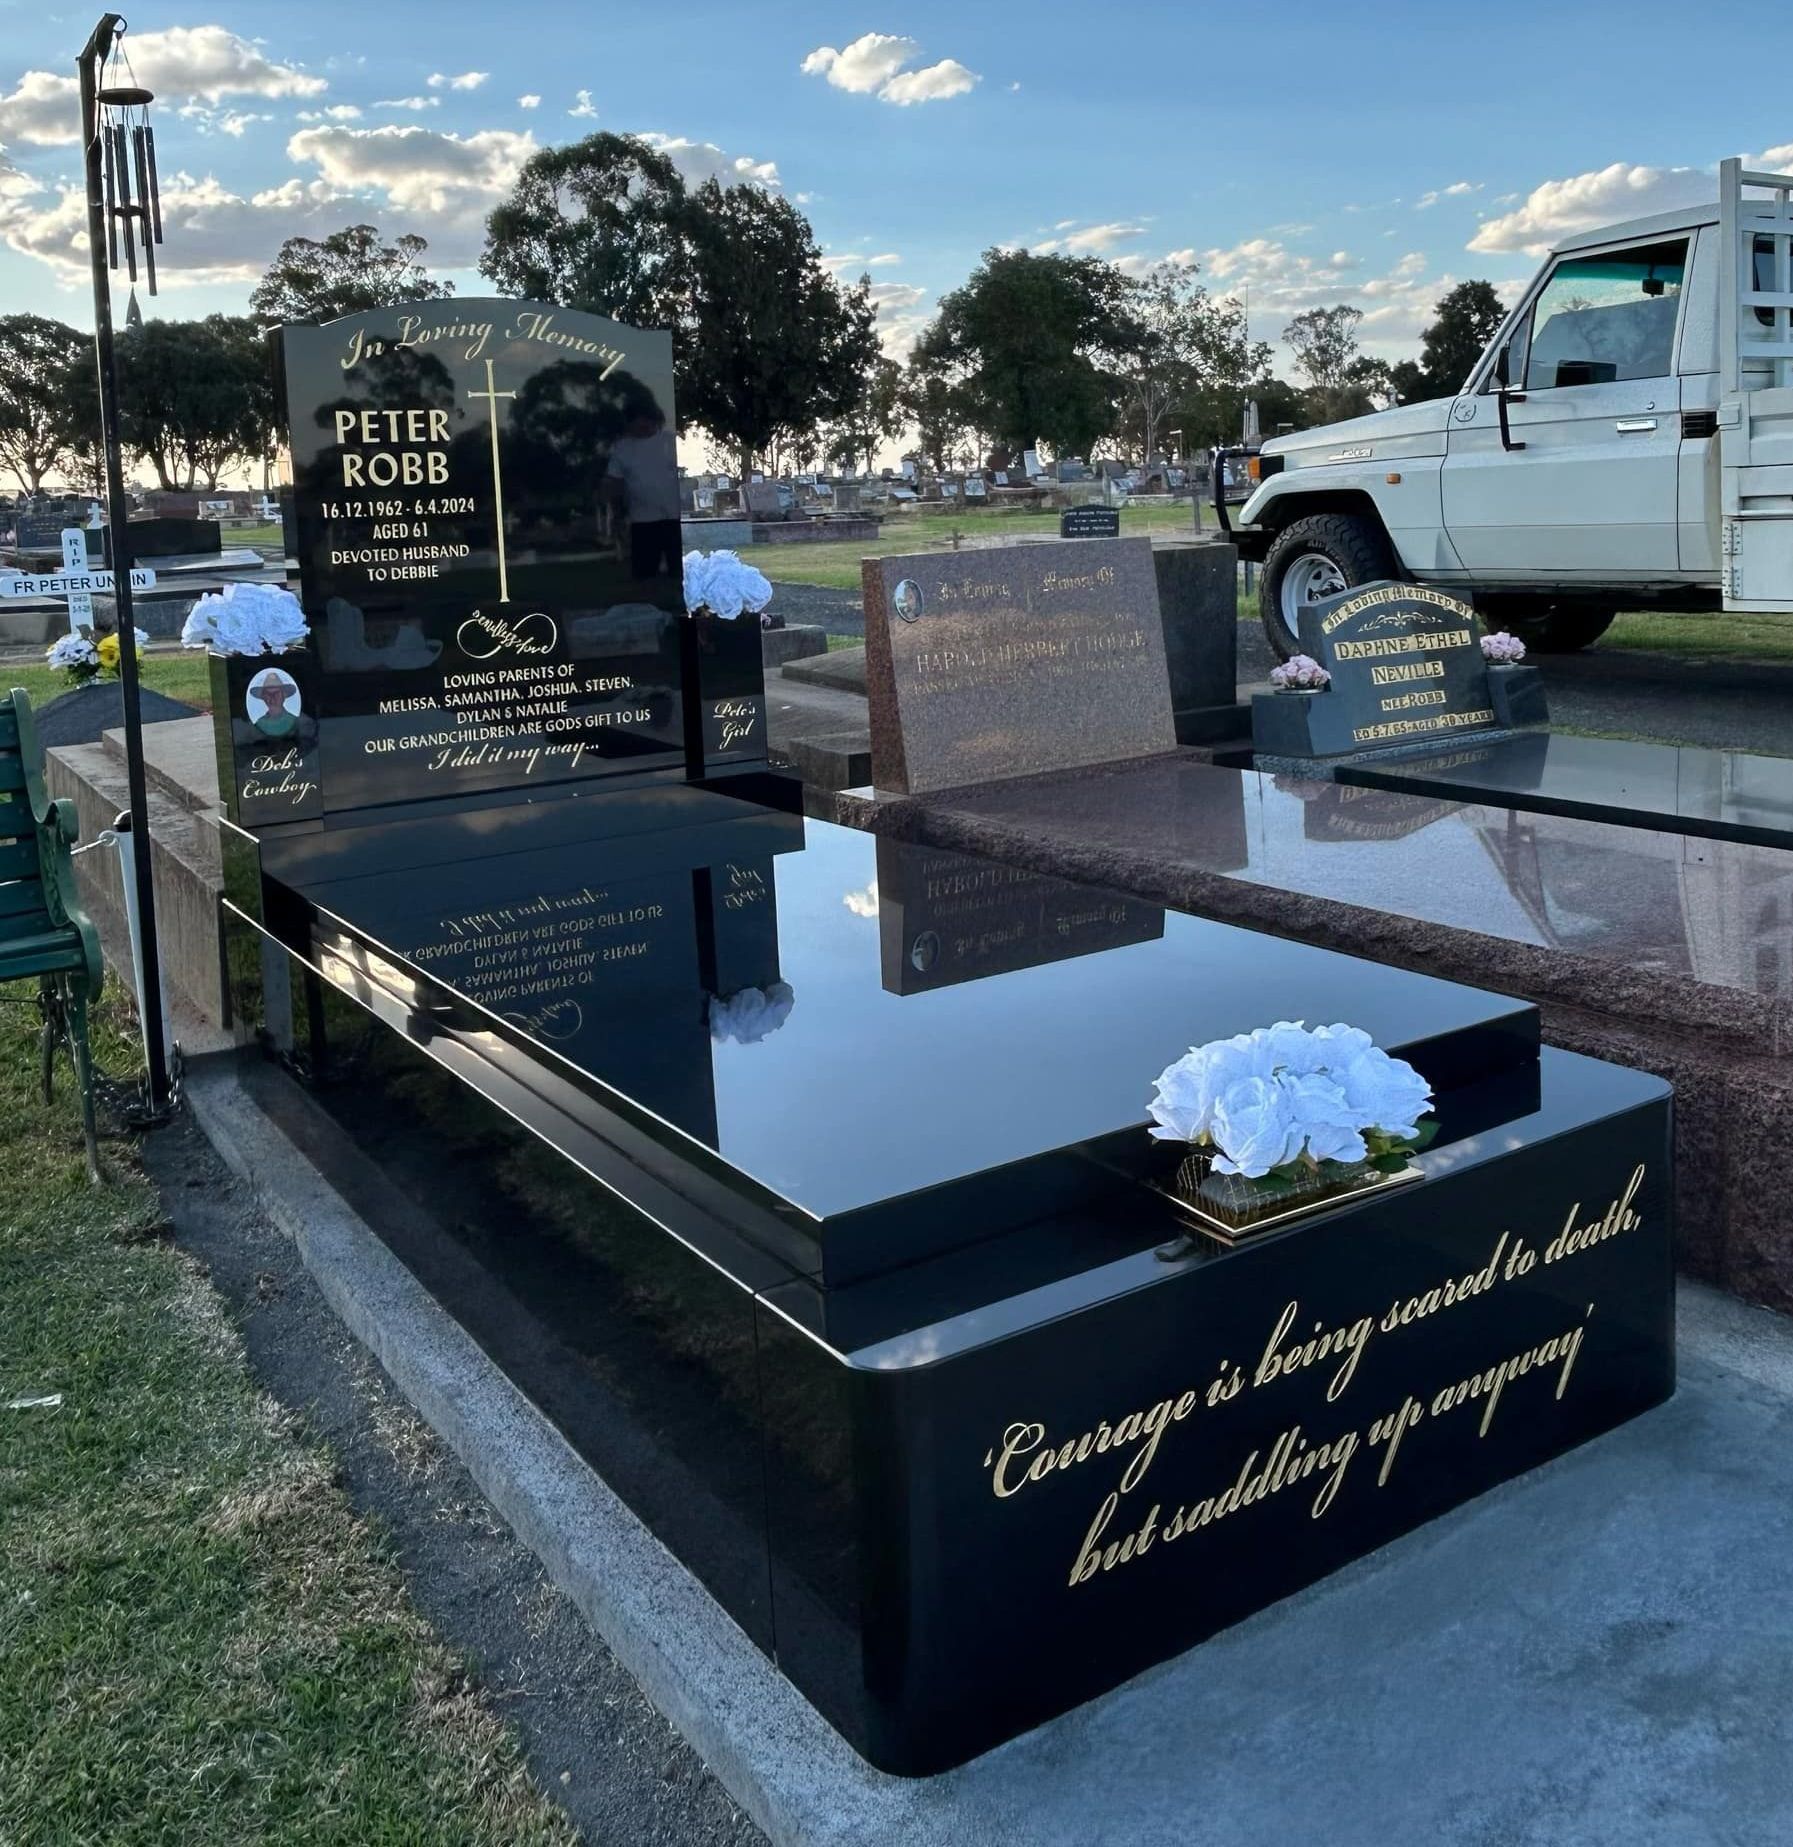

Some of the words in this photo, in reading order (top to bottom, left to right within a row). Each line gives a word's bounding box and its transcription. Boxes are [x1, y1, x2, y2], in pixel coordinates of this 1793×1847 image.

[341, 328, 385, 370] In
[394, 315, 495, 360] Loving
[505, 312, 626, 381] Memory
[335, 409, 451, 444] PETER
[343, 452, 450, 487] ROBB
[322, 502, 403, 519] 16.12.1962
[415, 498, 475, 515] 6.4.2024
[373, 523, 409, 540] AGED
[413, 521, 428, 538] 61
[331, 547, 399, 565] DEVOTED
[402, 544, 470, 562] HUSBAND
[14, 581, 35, 593] FR
[40, 578, 91, 592] PETER
[96, 574, 146, 588] UNIN
[367, 567, 387, 582] TO
[391, 565, 439, 580] DEBBIE
[1337, 640, 1409, 659] DAPHNE
[1415, 632, 1469, 650] ETHEL
[443, 671, 495, 689] LOVING
[499, 665, 555, 683] PARENTS
[557, 663, 575, 677] OF
[1374, 662, 1442, 683] NEVILLE
[456, 708, 501, 725] DYLAN
[516, 700, 569, 718] NATALIE
[1408, 692, 1444, 707] ROBB
[364, 738, 396, 753] OUR
[399, 725, 515, 750] GRANDCHILDREN
[518, 721, 542, 736] ARE
[545, 717, 582, 732] GODS
[585, 713, 612, 728] GIFT
[616, 711, 633, 724] TO
[636, 708, 651, 721] US
[719, 719, 754, 750] Girl
[251, 747, 303, 773] Deb's
[428, 748, 451, 770] I
[451, 743, 489, 767] did
[488, 746, 504, 763] it
[507, 747, 540, 774] my
[243, 771, 317, 804] Cowboy
[1206, 1360, 1245, 1407] is
[1254, 1301, 1375, 1402] being
[1381, 1231, 1510, 1332] scared
[1504, 1239, 1539, 1281] to
[1545, 1163, 1645, 1264] death,
[1068, 1492, 1161, 1588] but
[1163, 1425, 1361, 1542] saddling
[1369, 1396, 1424, 1487] up
